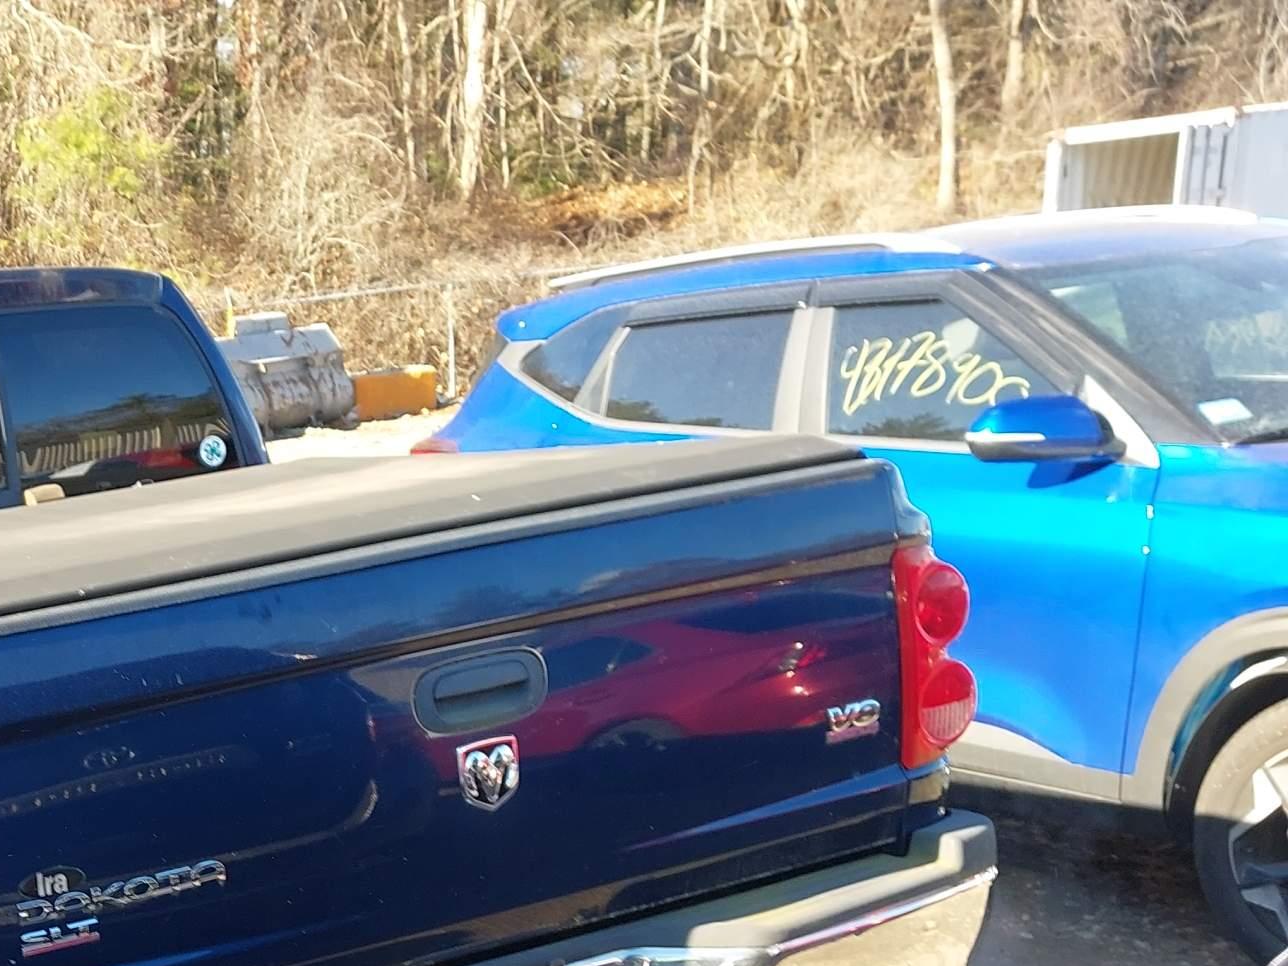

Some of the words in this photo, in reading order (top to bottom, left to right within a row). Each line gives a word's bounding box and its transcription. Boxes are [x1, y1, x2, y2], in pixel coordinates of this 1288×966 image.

[15, 859, 228, 925] DAKOTA
[34, 871, 70, 898] Ira
[19, 917, 100, 949] SLT
